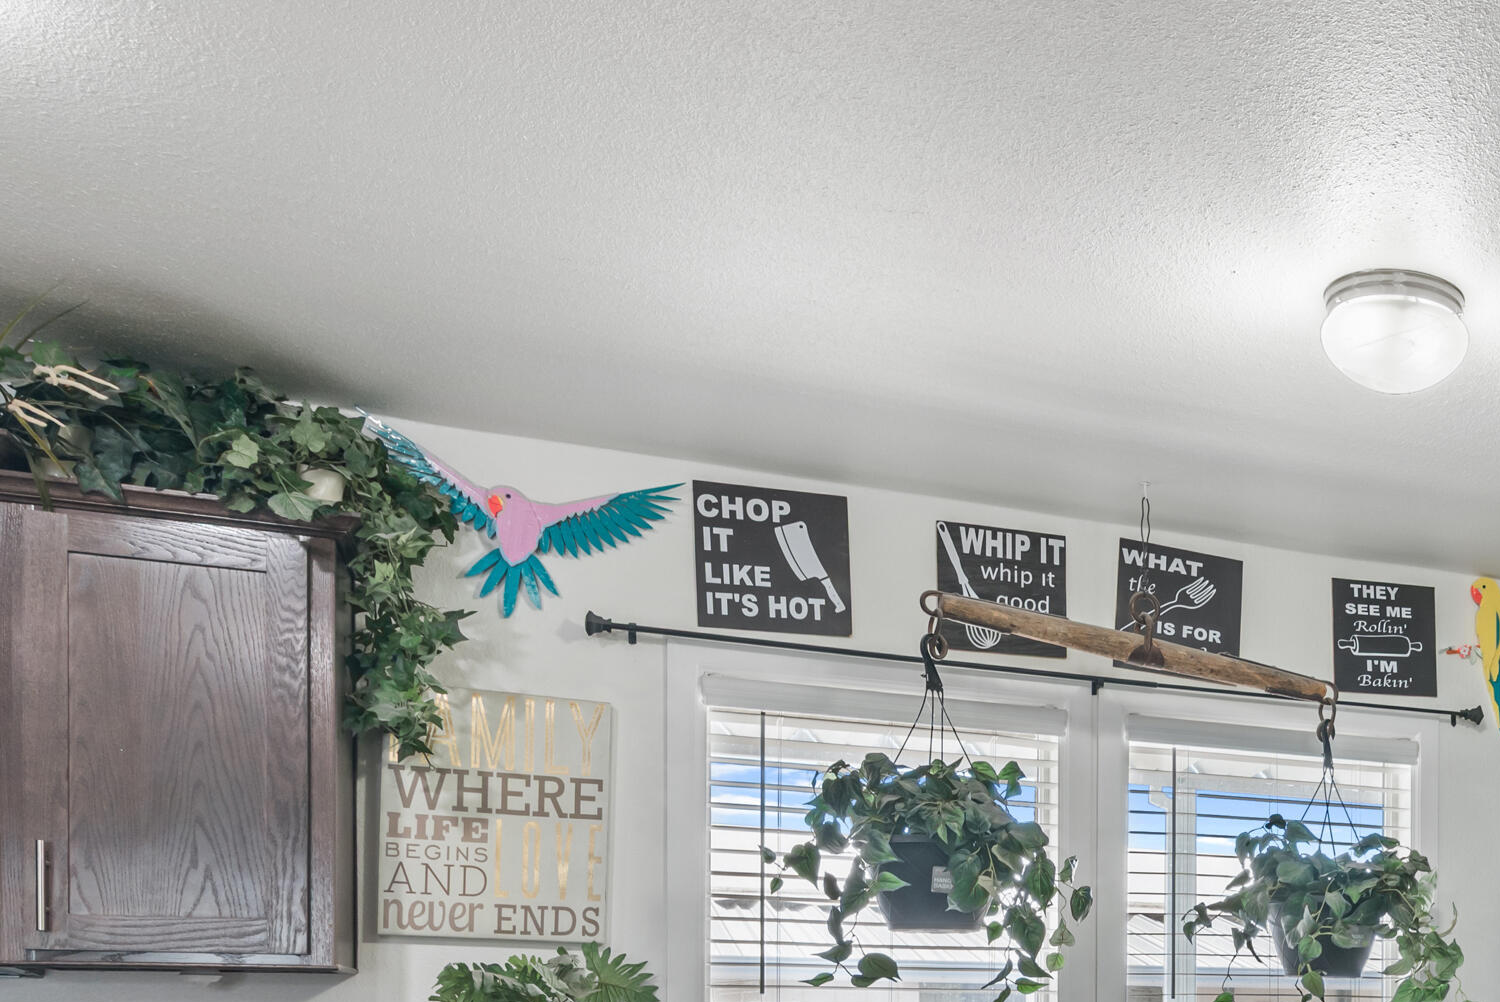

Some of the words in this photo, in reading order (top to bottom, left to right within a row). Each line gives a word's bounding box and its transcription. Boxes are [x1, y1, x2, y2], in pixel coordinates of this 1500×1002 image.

[697, 494, 790, 523] CHOP
[702, 526, 733, 552] IT
[959, 526, 1030, 561] WHIP
[1040, 537, 1064, 565] IT
[704, 562, 771, 587] LIKE
[981, 563, 1032, 588] whip
[1042, 572, 1055, 588] it
[1122, 548, 1203, 577] WHAT
[1350, 583, 1399, 600] THEY
[706, 591, 759, 617] IT'S
[768, 597, 825, 621] HOT
[1345, 603, 1380, 616] SEE
[1386, 606, 1412, 619] ME
[1156, 621, 1176, 636] IS
[1182, 625, 1221, 644] FOR
[1353, 619, 1407, 634] Rollin'
[1366, 659, 1398, 673] I'M
[1358, 673, 1413, 689] Bakin'
[389, 692, 605, 776] AMILY
[388, 763, 604, 821] WHERE
[385, 842, 488, 863] BEGINS
[386, 811, 489, 844] LIFE
[494, 818, 603, 902] LOVE
[383, 861, 488, 897] AND
[382, 899, 484, 933] never
[493, 903, 600, 937] ENDS
